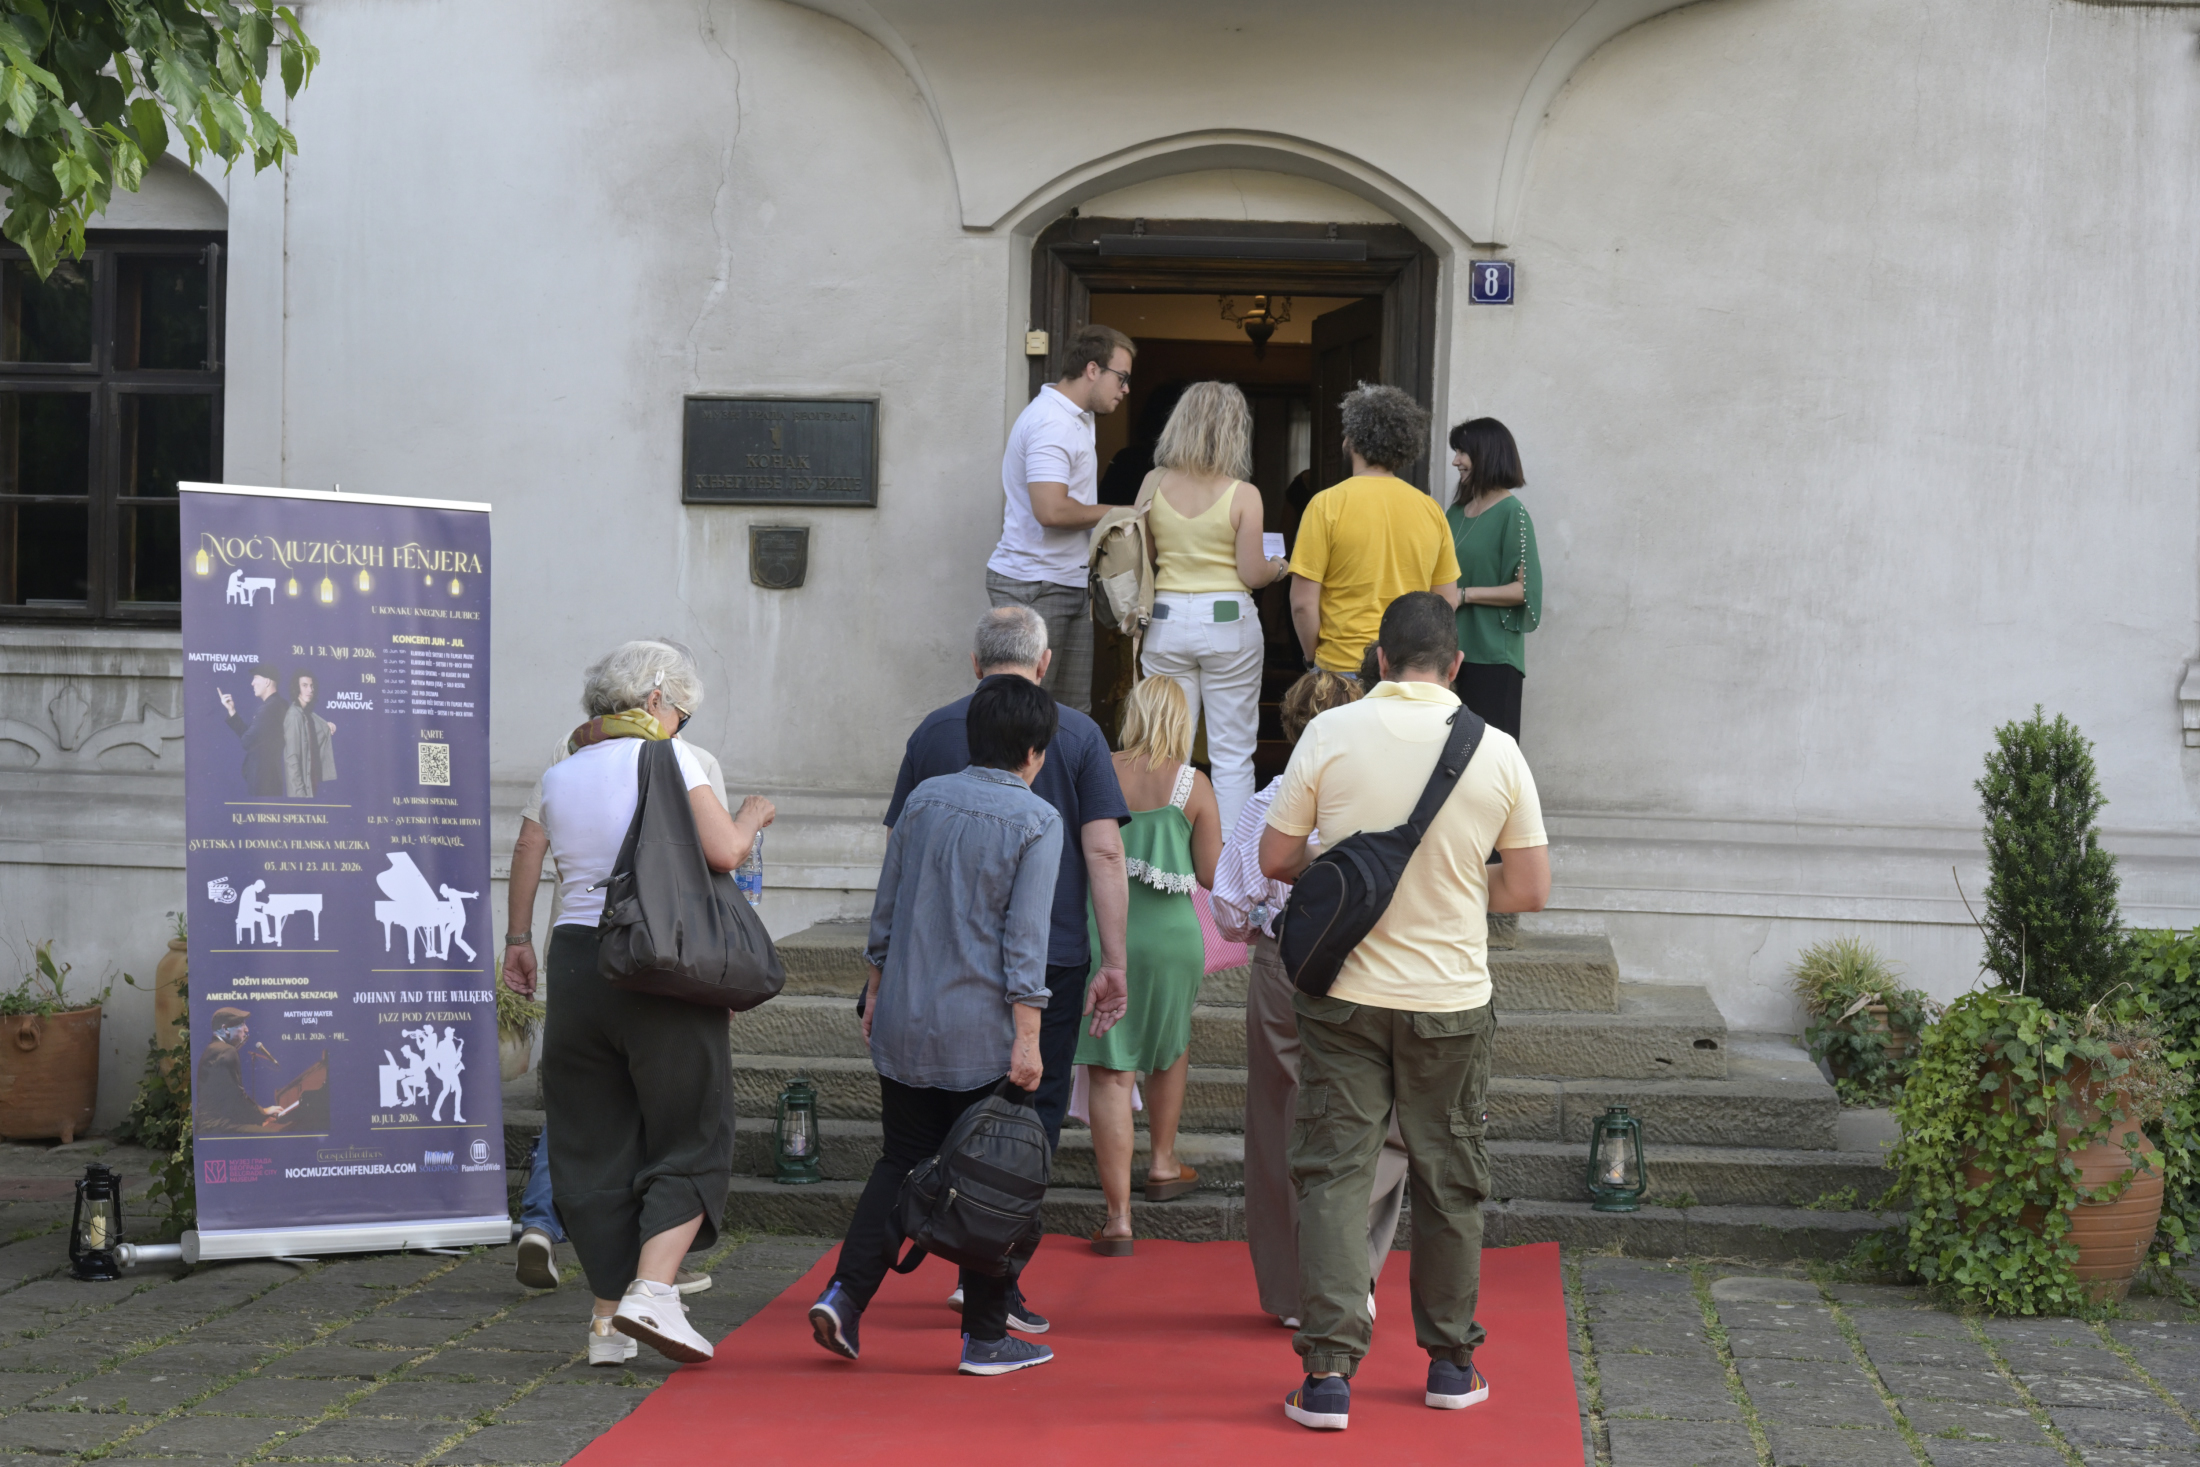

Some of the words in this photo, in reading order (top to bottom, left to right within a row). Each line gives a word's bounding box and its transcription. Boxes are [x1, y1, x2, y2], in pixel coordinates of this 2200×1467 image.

[1484, 266, 1499, 297] 8
[747, 411, 786, 421] ГРАДА
[793, 411, 857, 422] БЕОГРАДА
[746, 454, 810, 469] КОНАК
[695, 474, 782, 490] КЊЕГИЊЕ
[788, 477, 862, 491] ЉУБИЦЕ
[201, 533, 263, 566] NOĆ
[265, 536, 383, 569] MUZIČKIH
[380, 606, 412, 615] KONAKU
[414, 608, 447, 618] KNEGINJE
[450, 611, 480, 620] LJUBICE
[392, 635, 430, 645] KONCERTI
[431, 638, 445, 646] JUN
[451, 639, 464, 647] JUL
[292, 645, 305, 655] 30.
[318, 646, 328, 656] 31.
[353, 648, 376, 658] 2026.
[189, 653, 228, 662] MATTHEW
[230, 654, 259, 663] MAYER
[213, 663, 236, 673] (USA)
[361, 674, 376, 683] 19h
[337, 691, 363, 700] MATEJ
[326, 699, 373, 710] JOVANOVIĆ
[421, 729, 444, 740] KARTE
[393, 797, 429, 805] KLAVIRSKI
[233, 814, 280, 824] KLAVIRSKI
[189, 839, 235, 852] SVETSKA
[291, 840, 330, 849] FILMSKA
[334, 841, 370, 850] MUZIKA
[265, 862, 277, 871] 05.
[280, 862, 296, 871] JUN
[306, 862, 318, 871] 23.
[341, 862, 362, 871] 2026.
[233, 976, 260, 986] DOŽIVI
[206, 991, 248, 1000] AMERIČKA
[250, 990, 298, 1001] PIJANISTIČKA
[301, 992, 338, 1000] SENZACIJA
[353, 991, 396, 1003] JOHNNY
[400, 991, 423, 1003] AND
[427, 991, 447, 1002] THE
[450, 990, 493, 1004] WALKERS
[378, 1013, 399, 1024] JAZZ
[402, 1012, 422, 1022] POD
[426, 1012, 471, 1021] ZVEZDAMA
[399, 1114, 419, 1122] 2026.
[285, 1163, 417, 1179] NOCMUZICKIHFENJERA.COM
[462, 1164, 500, 1172] PianoWorldWide
